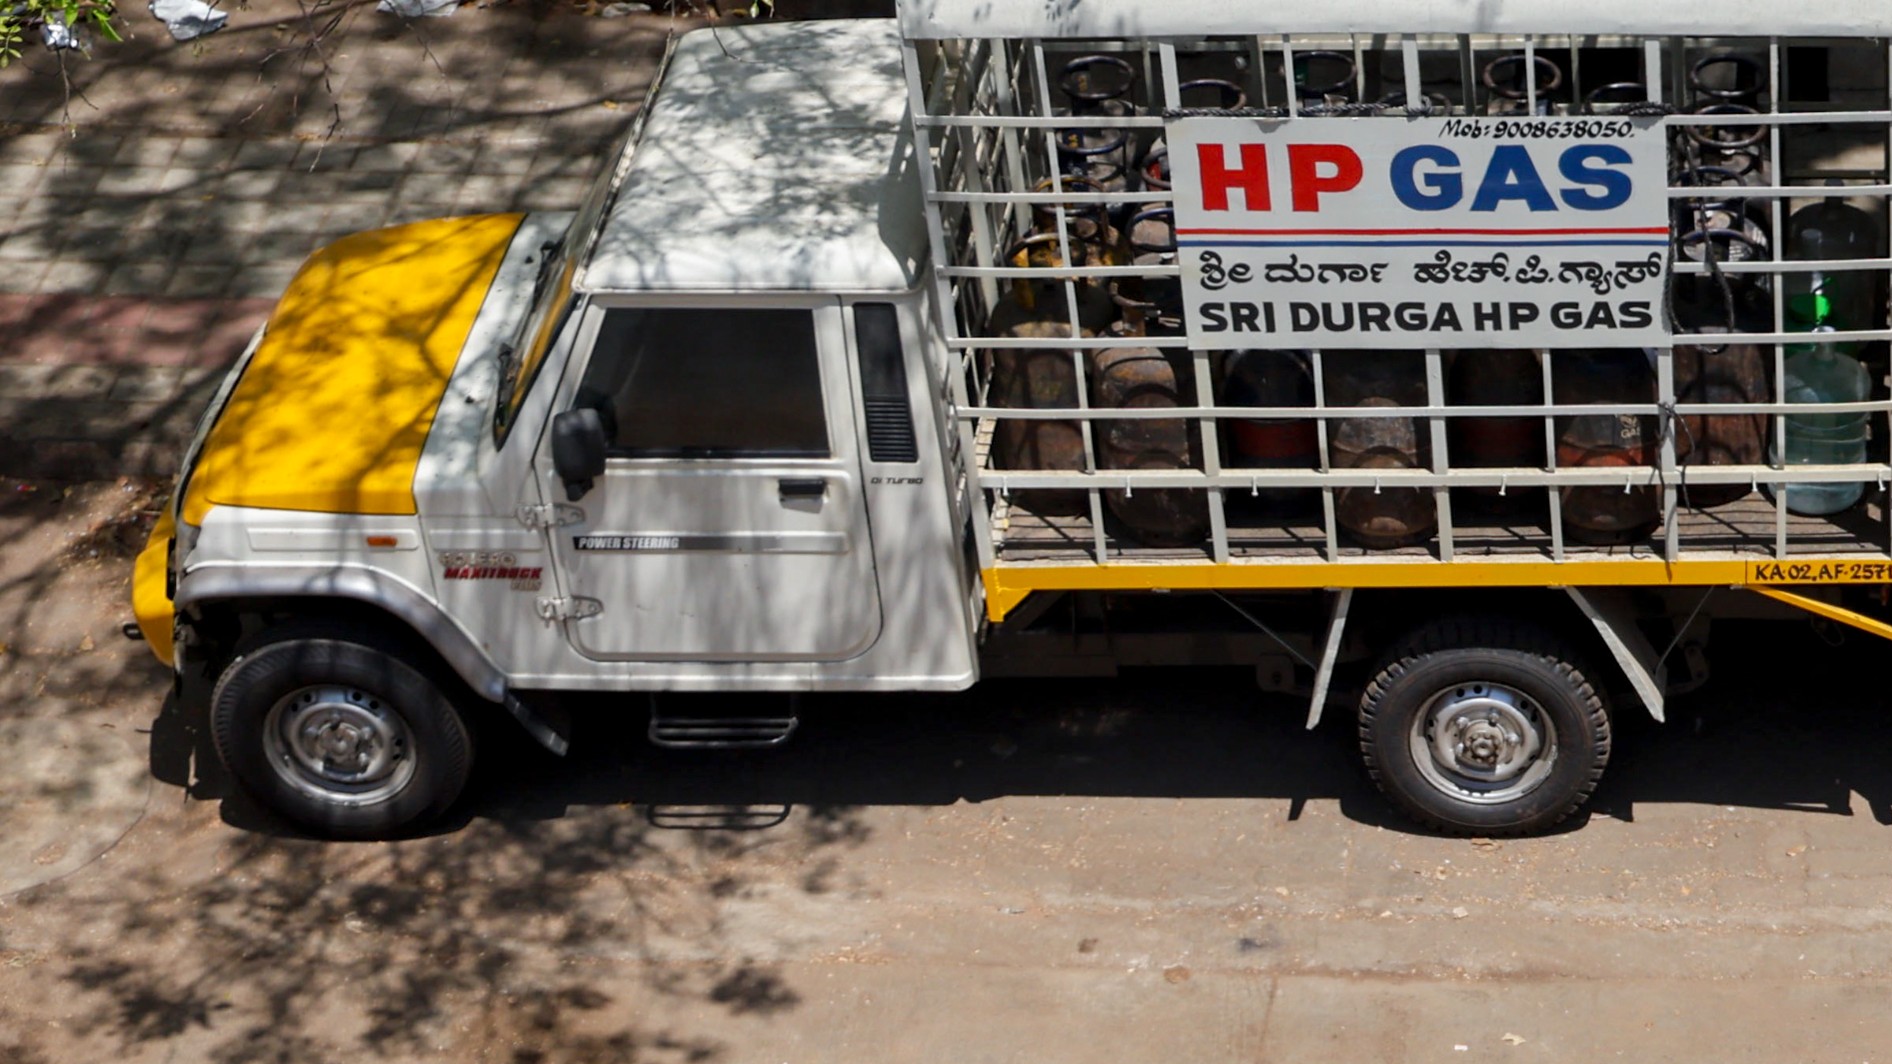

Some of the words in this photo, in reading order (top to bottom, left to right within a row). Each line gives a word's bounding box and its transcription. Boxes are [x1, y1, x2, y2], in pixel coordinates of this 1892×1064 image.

[1196, 143, 1363, 212] HP
[1389, 143, 1634, 212] GAS
[1199, 250, 1253, 291] ಶ್ರೀ
[1264, 253, 1389, 283] ದುರ್ಗಾ
[1199, 301, 1276, 333] SRI
[1289, 301, 1463, 332] DURGA
[1473, 301, 1539, 331] HP
[1550, 301, 1653, 330] GAS
[578, 537, 620, 549] POWER
[622, 537, 680, 549] STEERING
[438, 551, 517, 567] BOLERO
[443, 566, 543, 580] MAXITRUCK
